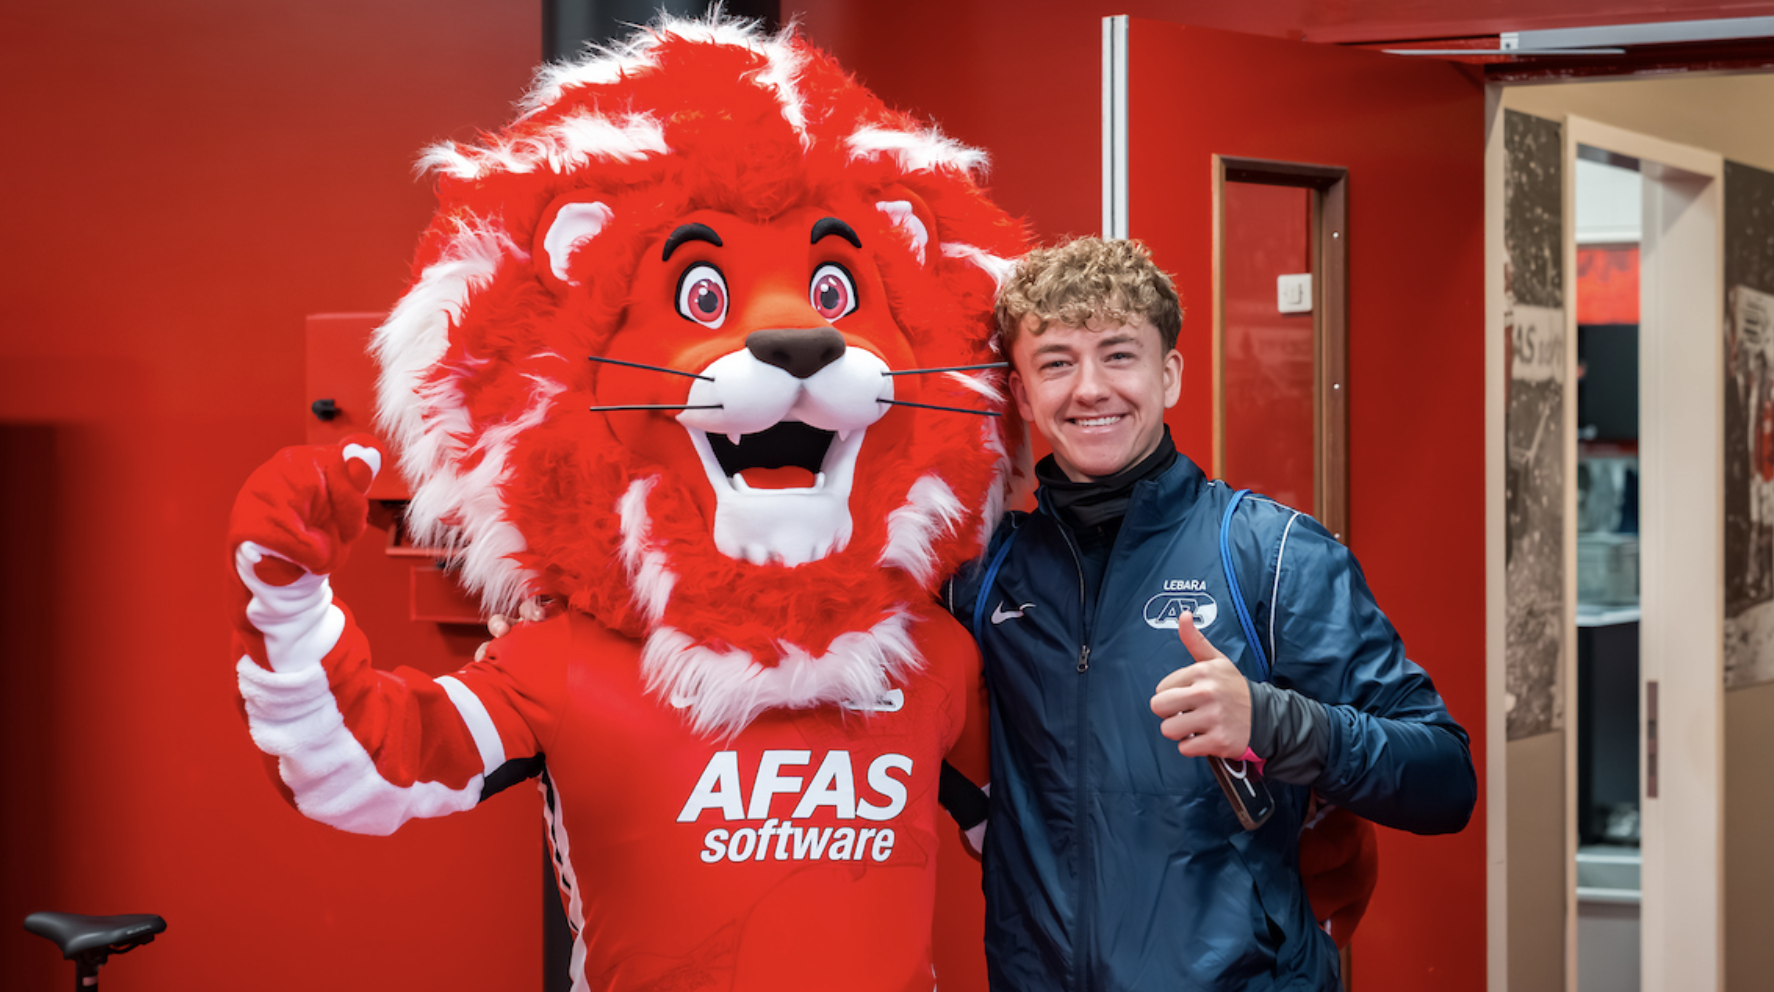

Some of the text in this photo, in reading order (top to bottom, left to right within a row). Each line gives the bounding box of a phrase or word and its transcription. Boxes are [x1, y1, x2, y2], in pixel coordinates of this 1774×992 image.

[1163, 579, 1206, 591] LEBARA
[676, 749, 914, 821] AFAS
[700, 818, 895, 863] software
